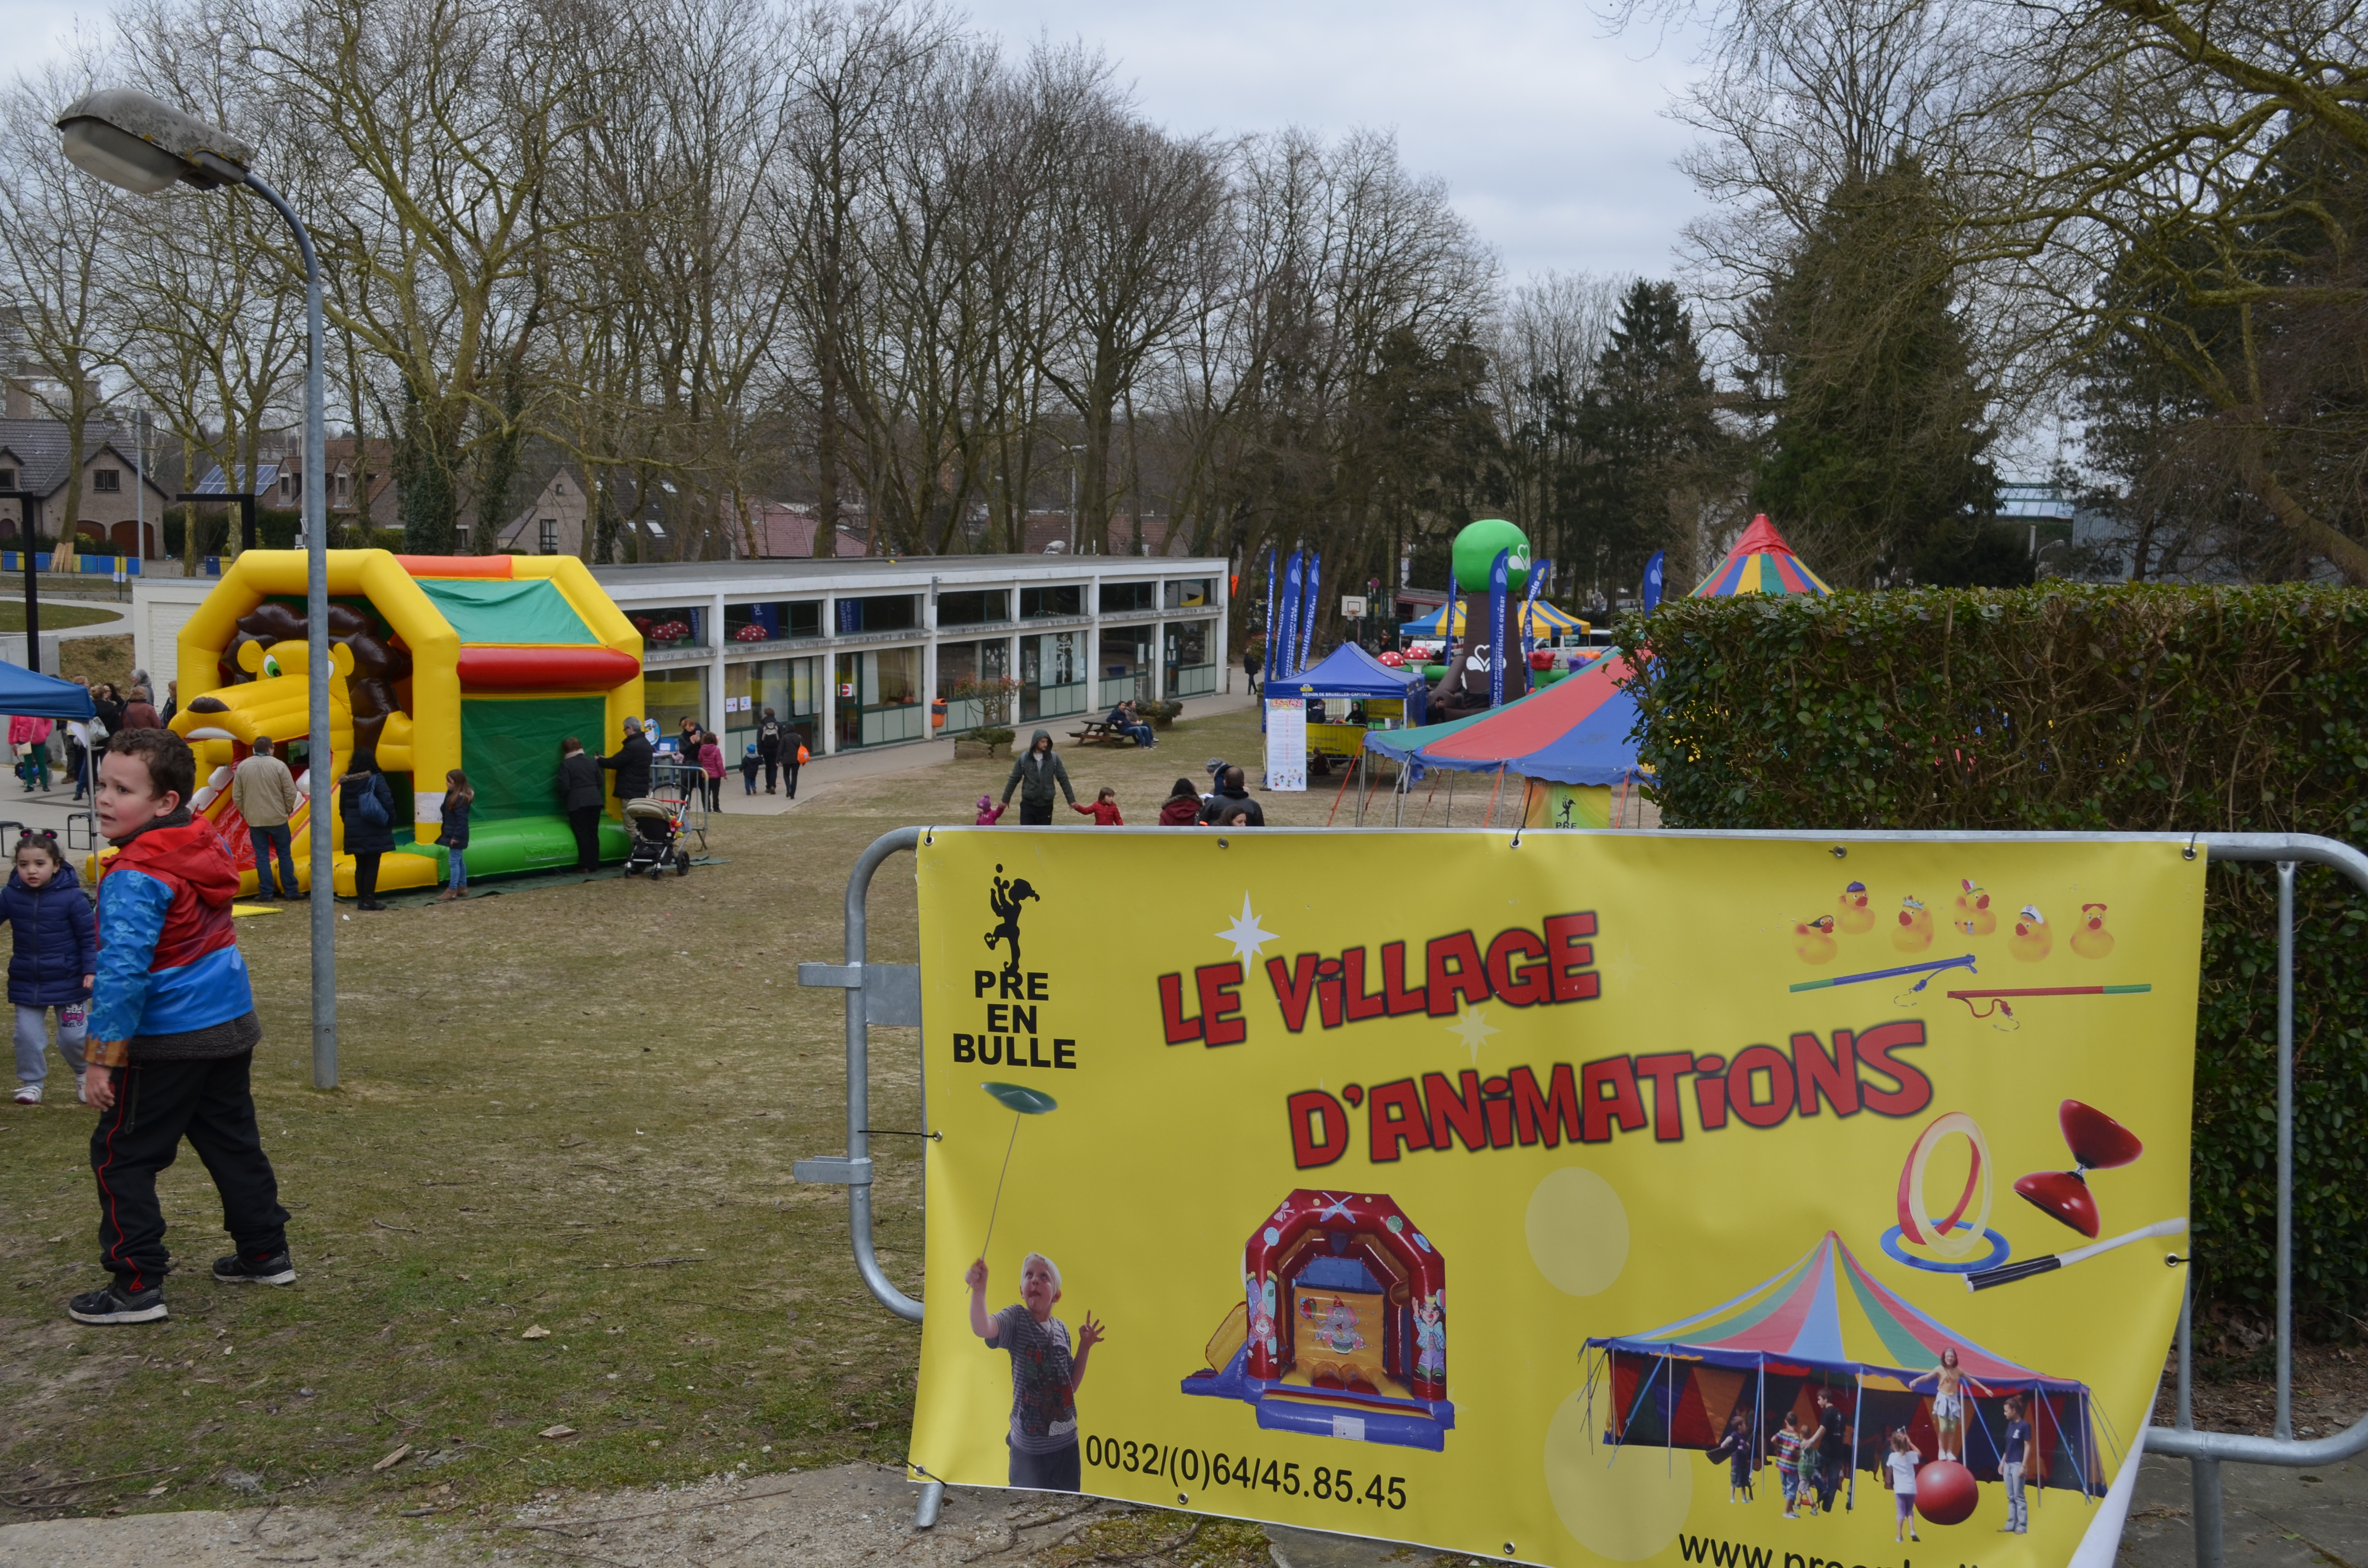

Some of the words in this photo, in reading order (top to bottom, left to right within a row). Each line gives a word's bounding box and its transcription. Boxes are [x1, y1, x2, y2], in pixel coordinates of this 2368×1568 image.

[975, 970, 1049, 1001] PRE
[987, 1004, 1037, 1034] EN
[1158, 961, 1247, 1049] LE
[953, 1033, 1076, 1069] BULLE
[1086, 1435, 1406, 1510] 0032/(0)64/45.85.45
